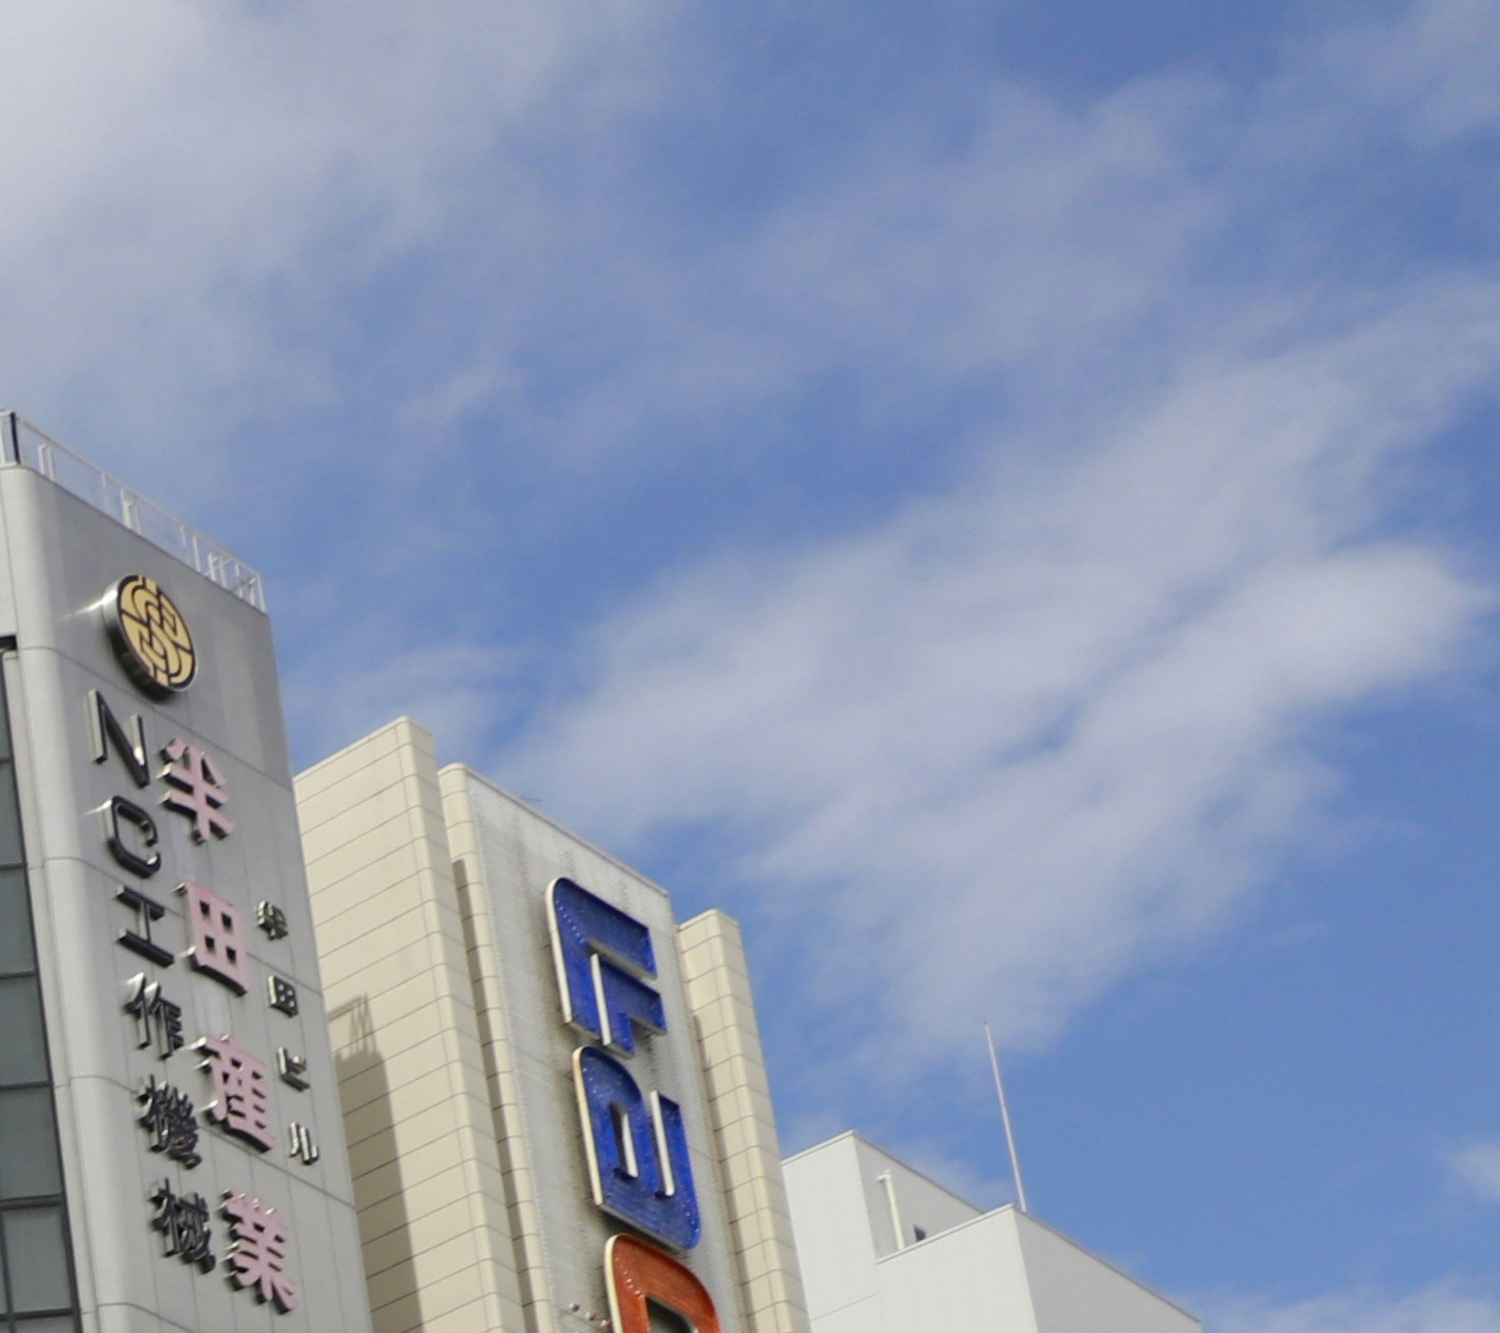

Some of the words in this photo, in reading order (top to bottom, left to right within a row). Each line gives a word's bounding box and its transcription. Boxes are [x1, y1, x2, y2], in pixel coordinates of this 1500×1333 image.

[160, 737, 298, 1313] 半田産業
[255, 898, 320, 1167] 半田ビル
